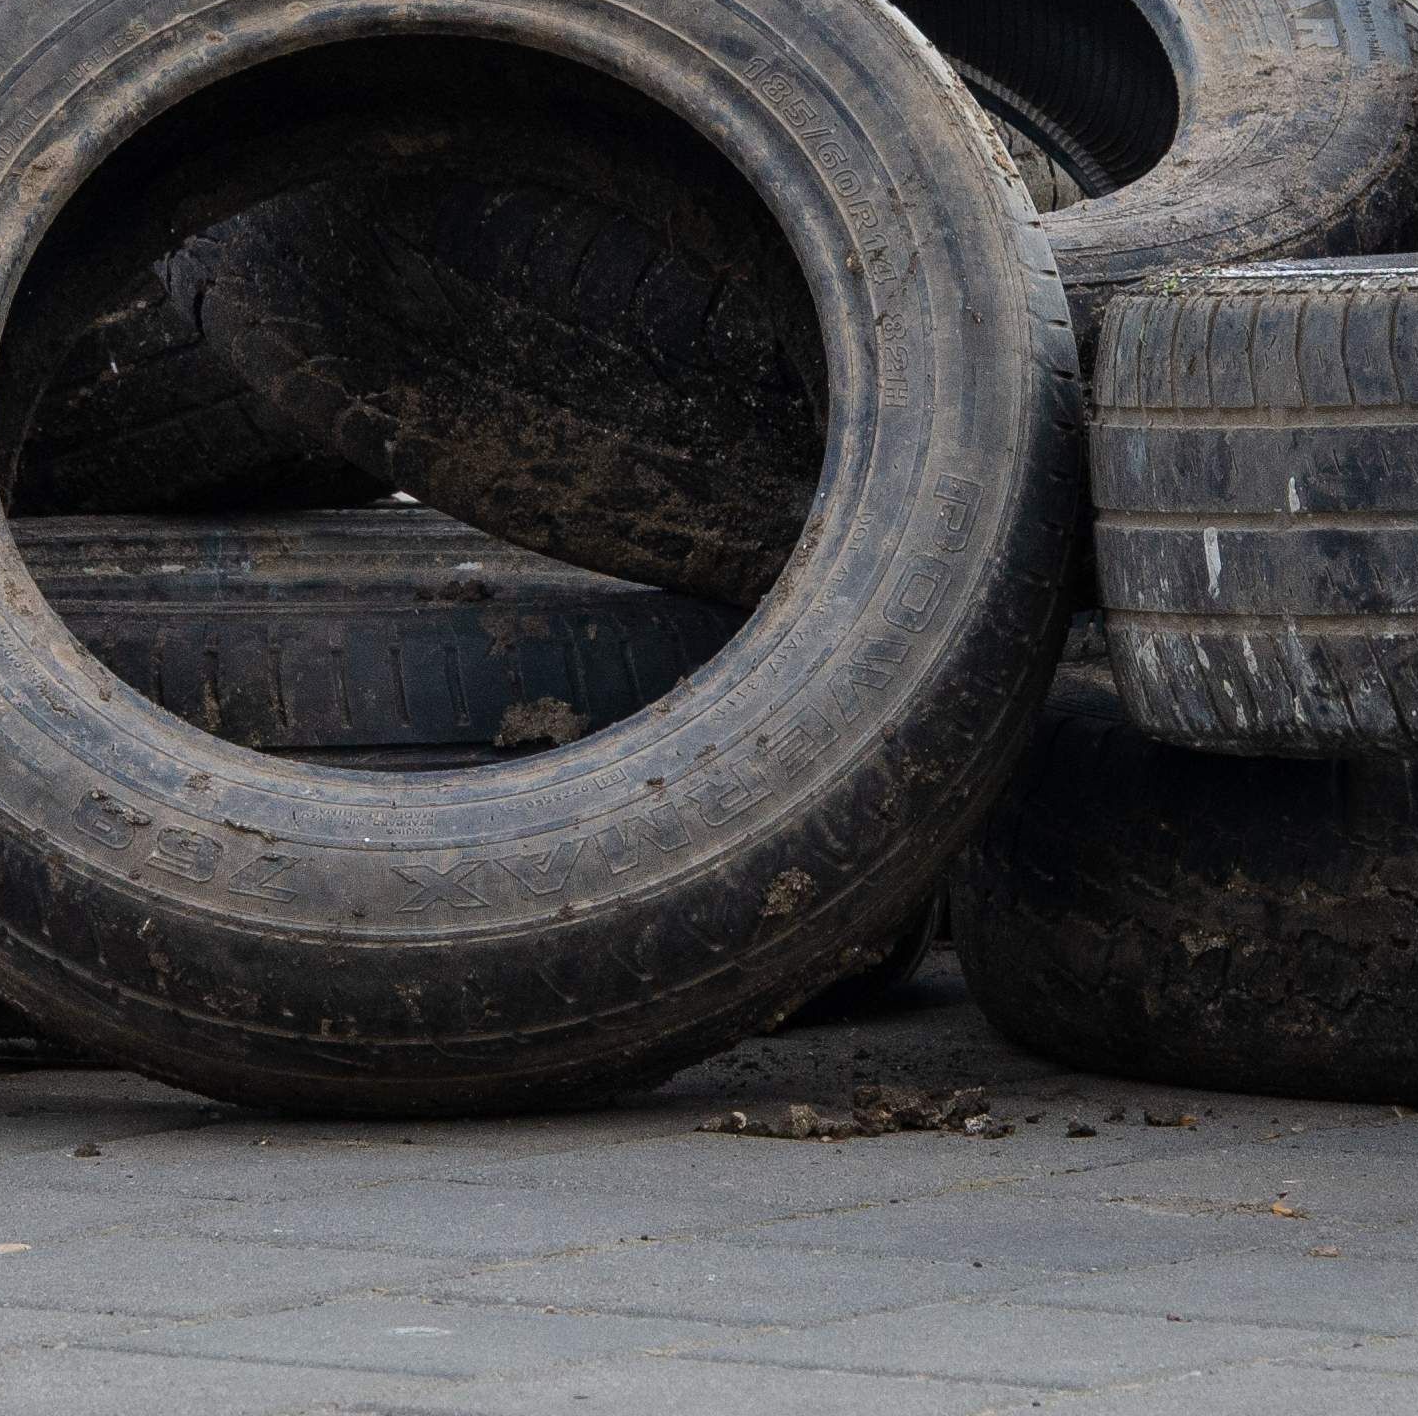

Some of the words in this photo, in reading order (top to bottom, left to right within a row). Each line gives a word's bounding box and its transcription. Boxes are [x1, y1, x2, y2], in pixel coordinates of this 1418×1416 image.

[63, 20, 149, 87] TUBELESS
[741, 55, 899, 286] 185/60R14
[391, 471, 987, 915] POWERMAX
